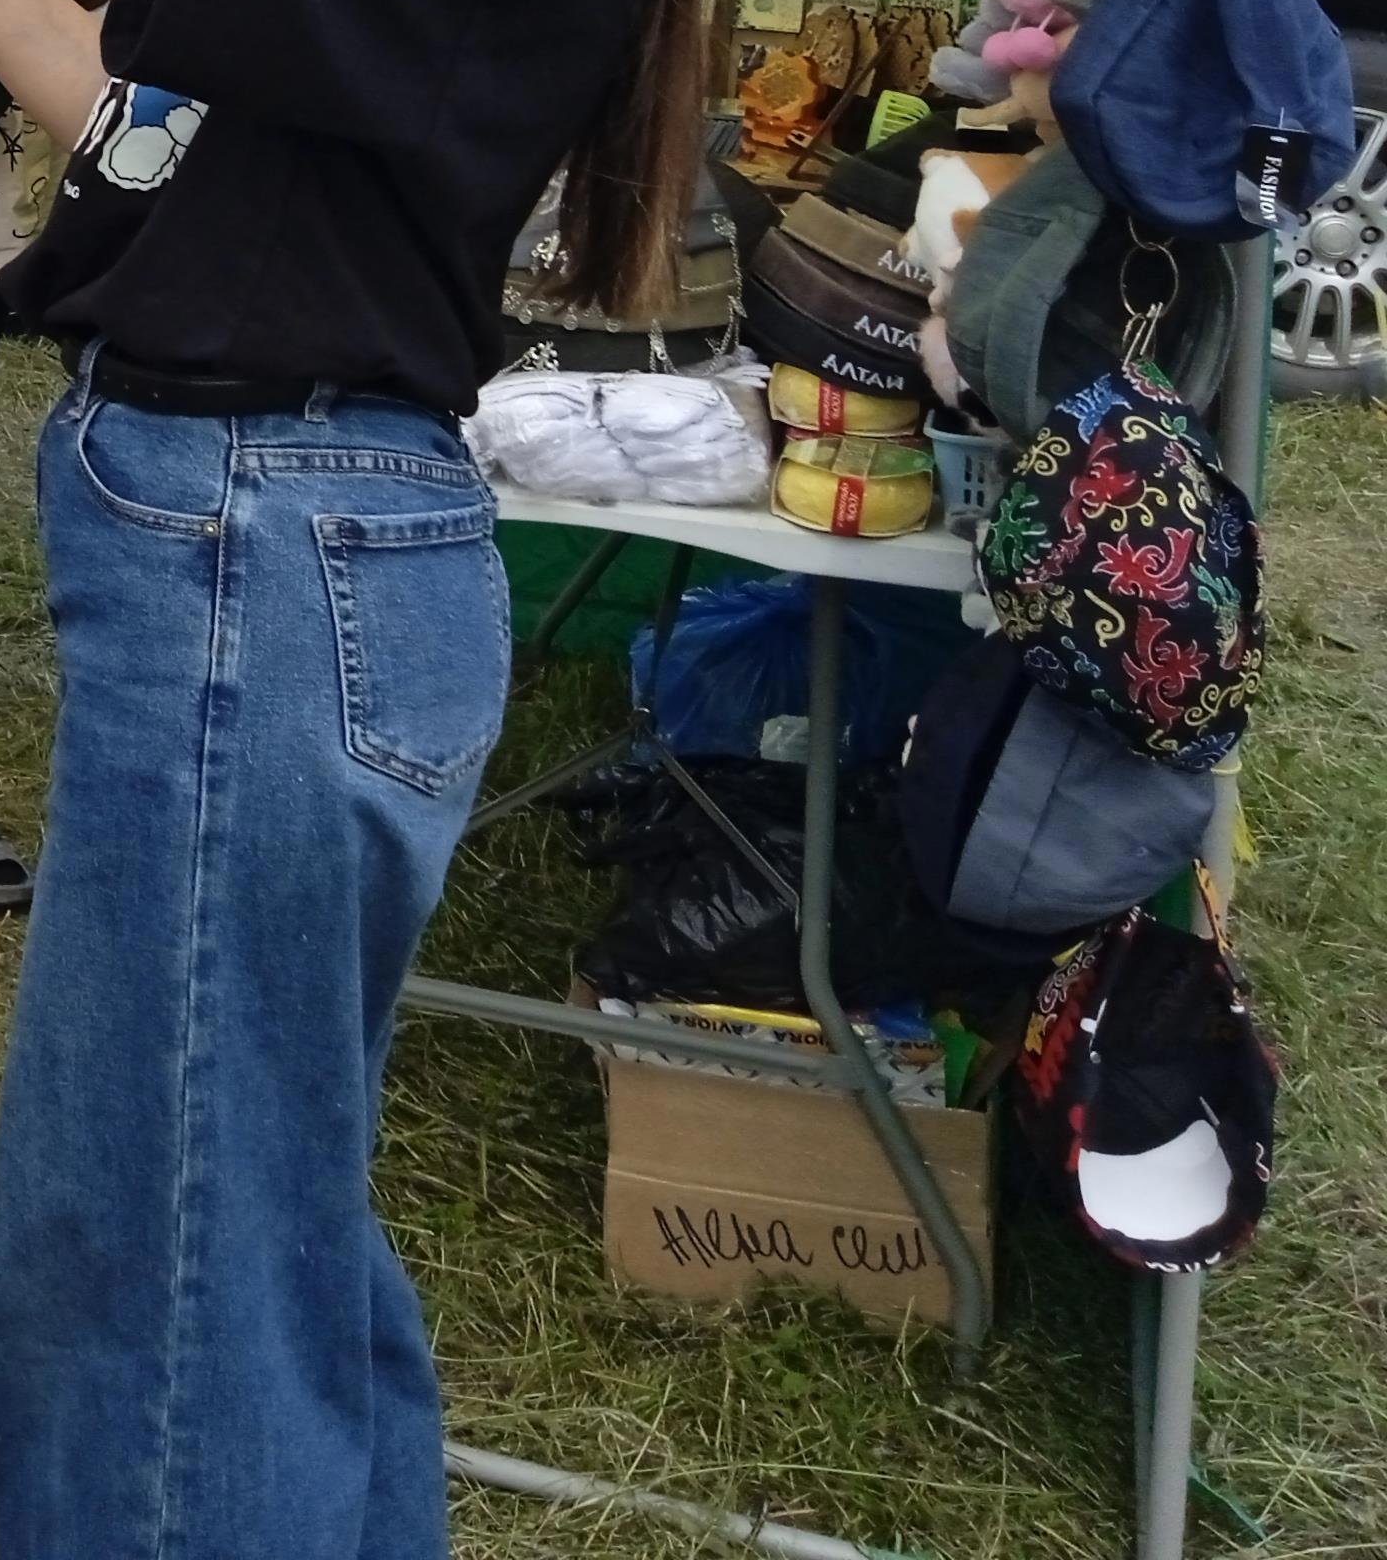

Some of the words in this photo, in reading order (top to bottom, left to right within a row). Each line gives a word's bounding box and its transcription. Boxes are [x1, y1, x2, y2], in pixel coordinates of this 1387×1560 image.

[1259, 155, 1283, 223] FASHION
[854, 315, 919, 353] АЛТА
[773, 1030, 831, 1050] IORA
